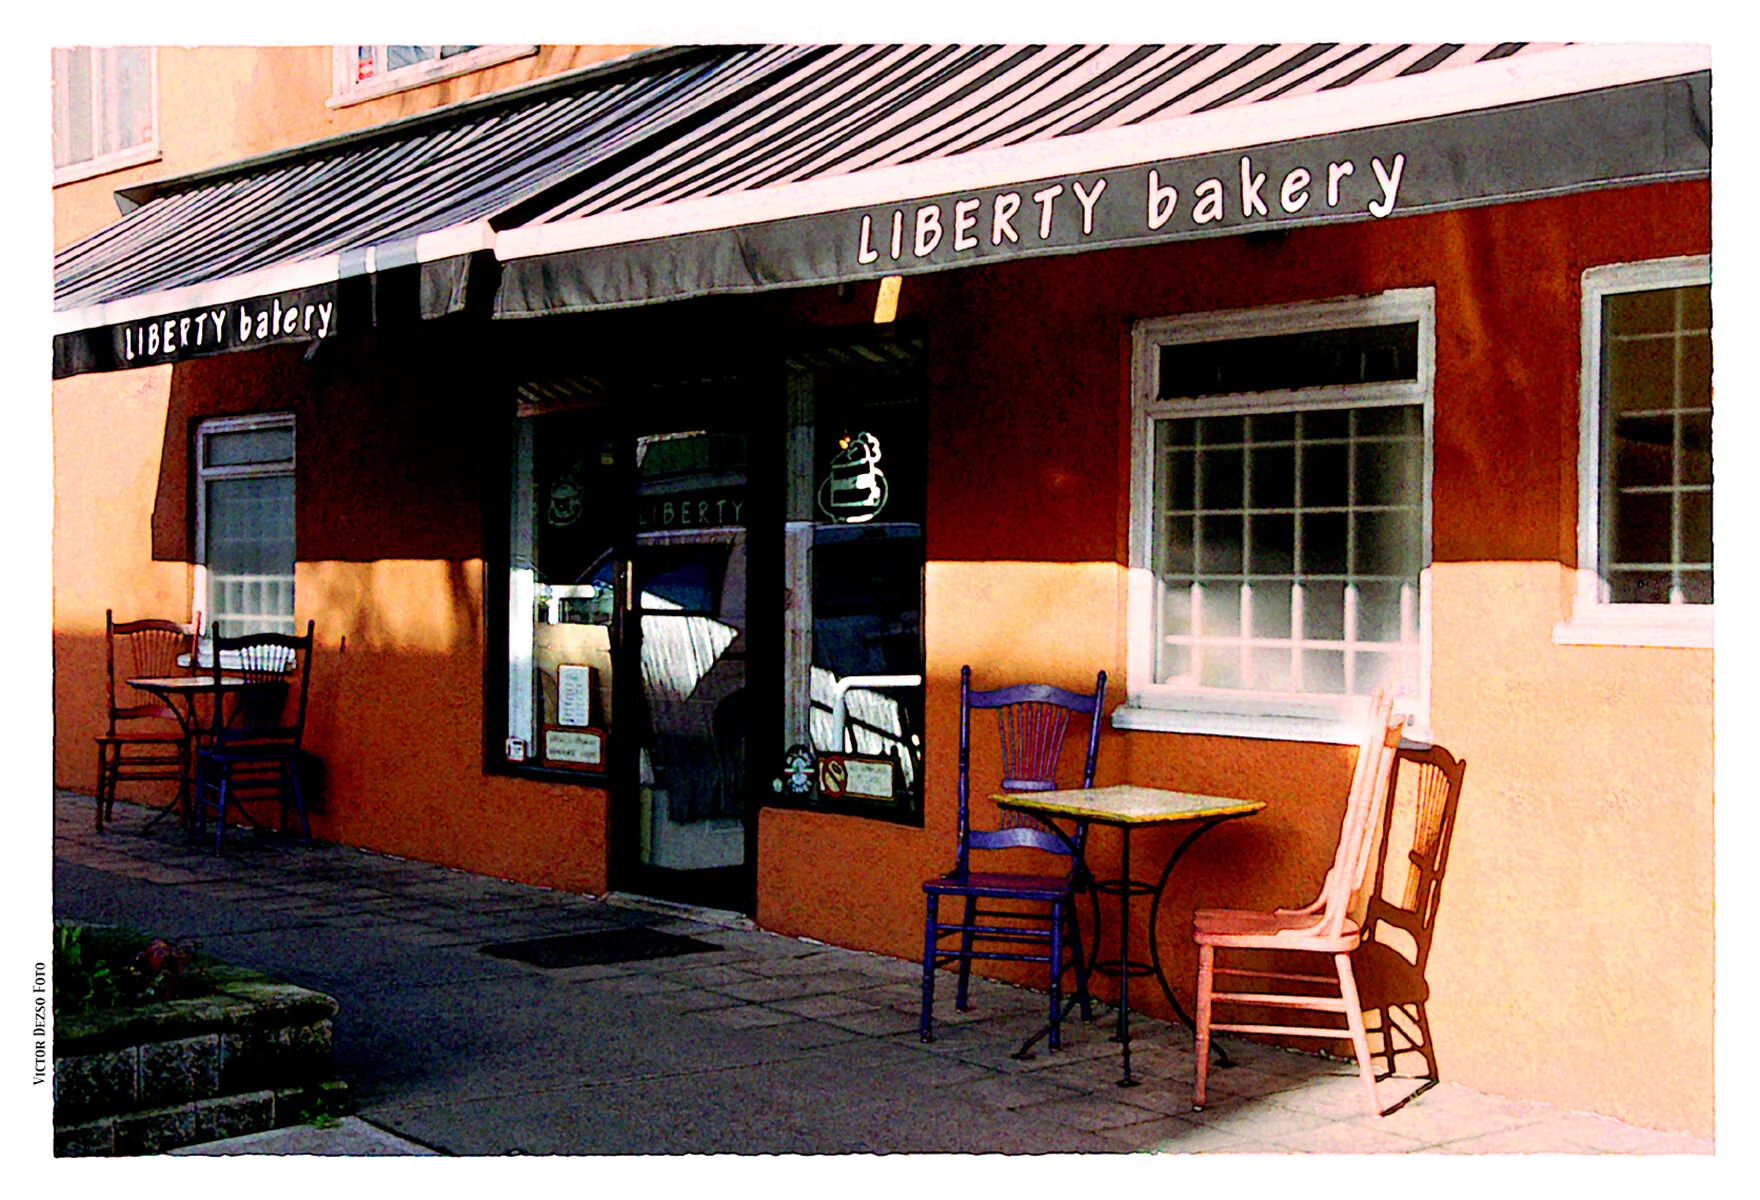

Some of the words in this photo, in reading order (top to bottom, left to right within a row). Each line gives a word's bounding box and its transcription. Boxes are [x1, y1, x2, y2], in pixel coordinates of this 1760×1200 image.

[858, 179, 1107, 265] LIBERTY
[1148, 154, 1405, 230] bakery
[125, 309, 226, 360] LIBERTY
[638, 499, 745, 525] LIBERTY
